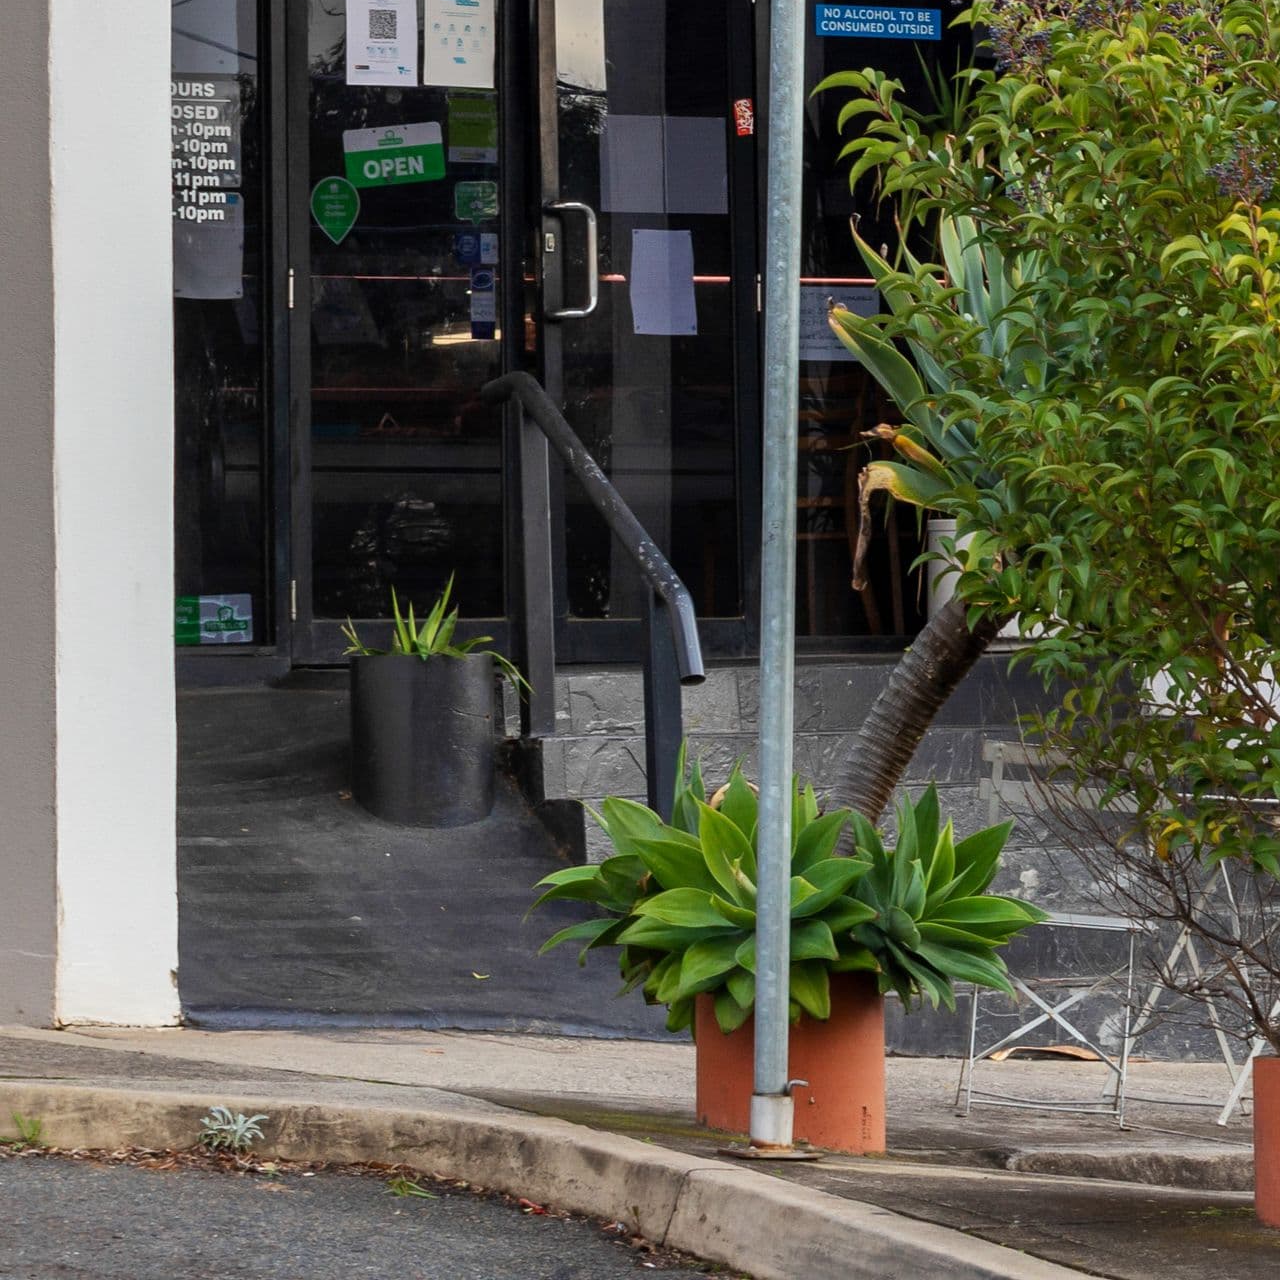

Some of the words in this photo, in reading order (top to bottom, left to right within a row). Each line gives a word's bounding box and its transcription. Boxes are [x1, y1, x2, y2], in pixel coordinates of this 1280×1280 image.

[824, 8, 841, 18] NO
[844, 9, 896, 21] ALCOHOL
[900, 11, 914, 22] TO
[918, 12, 931, 22] BE
[821, 21, 884, 33] CONSUMED
[888, 23, 934, 36] OUTSIDE
[171, 105, 219, 120] OSED
[363, 156, 425, 179] OPEN
